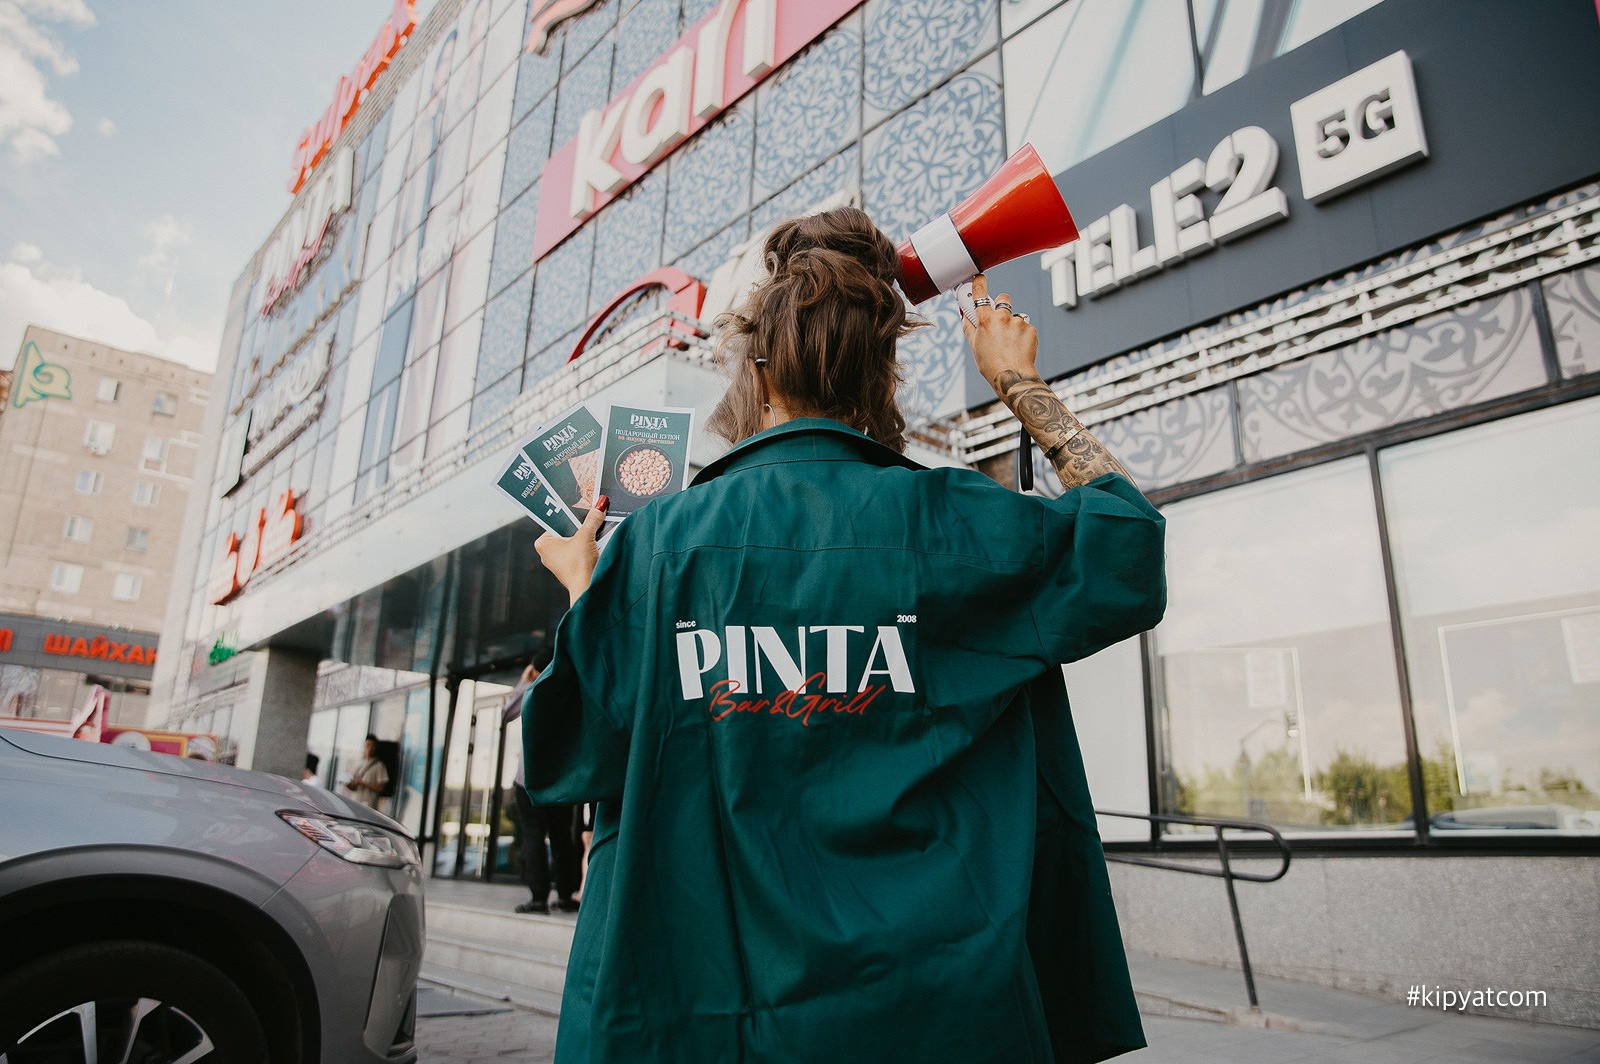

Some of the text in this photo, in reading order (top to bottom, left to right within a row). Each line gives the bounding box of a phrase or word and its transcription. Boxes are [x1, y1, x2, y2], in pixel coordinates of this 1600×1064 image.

[1313, 87, 1397, 160] 5G
[1041, 125, 1290, 310] TELE2
[615, 429, 658, 439] ПОДАРОЧНЫЙ
[630, 414, 668, 428] PINTA
[542, 425, 577, 451] PINTA
[676, 620, 696, 629] since
[897, 614, 917, 624] 2008
[676, 625, 916, 700] PINTA
[709, 672, 887, 727] Bar&Grill
